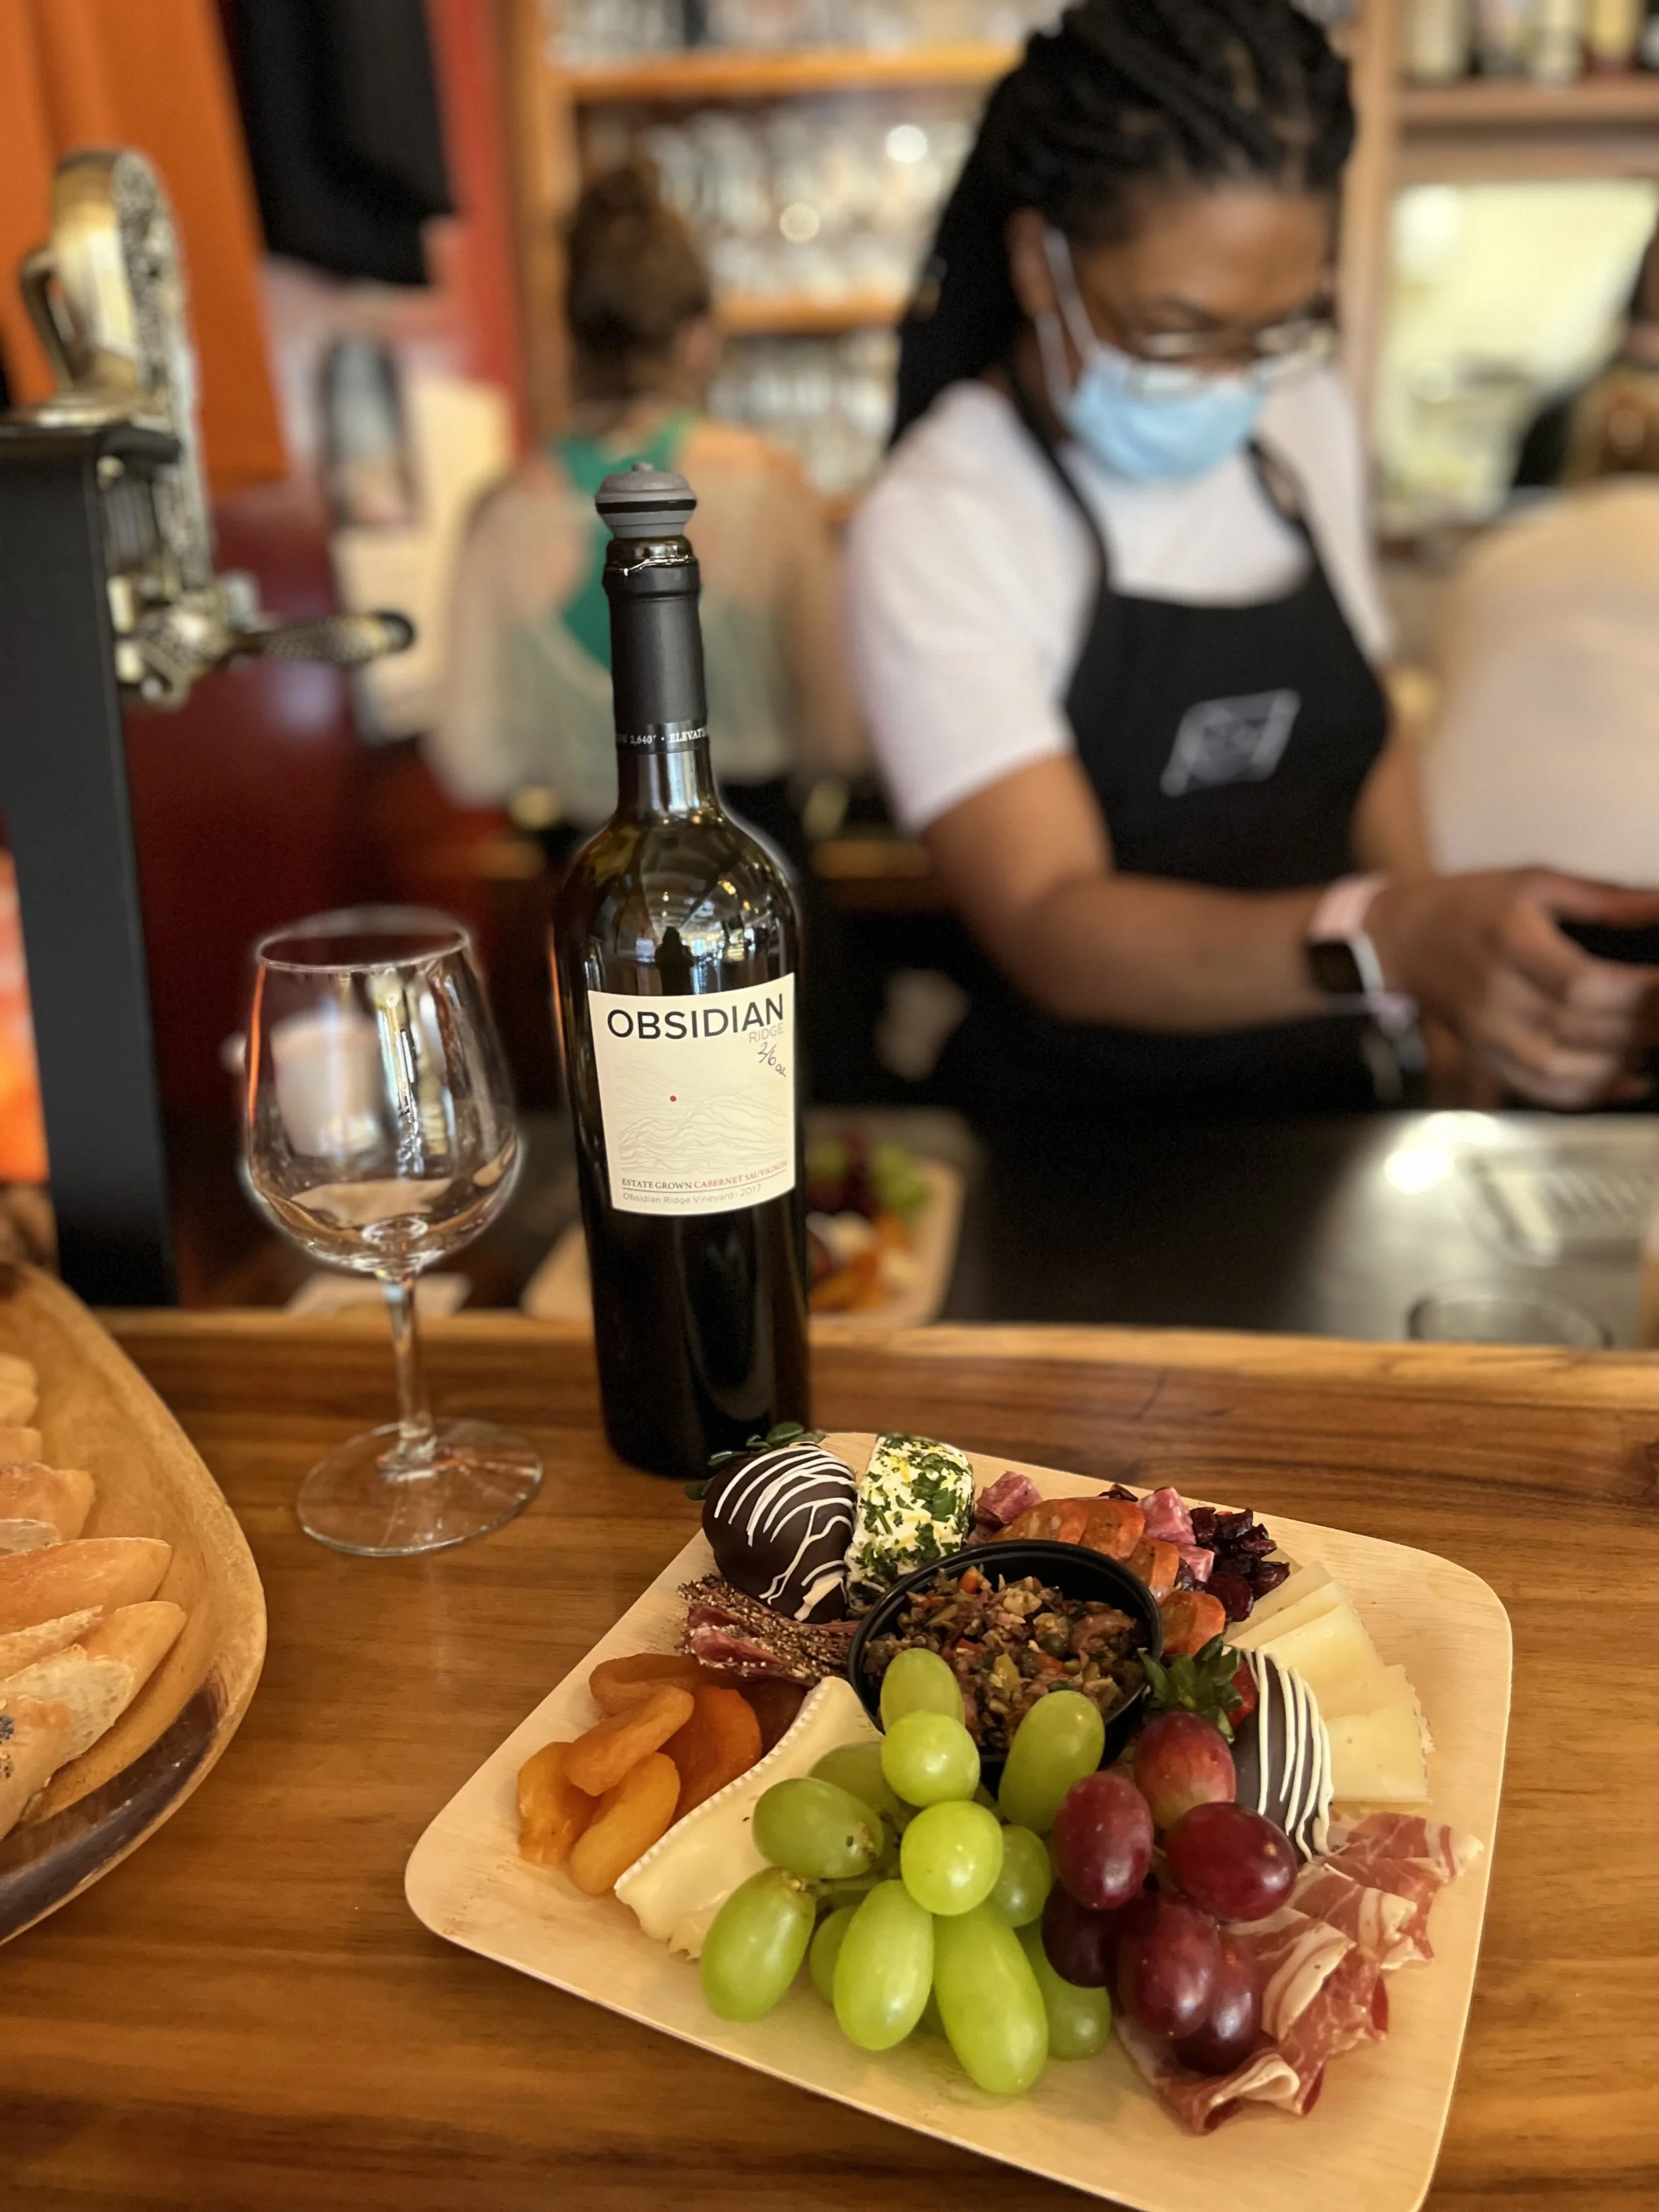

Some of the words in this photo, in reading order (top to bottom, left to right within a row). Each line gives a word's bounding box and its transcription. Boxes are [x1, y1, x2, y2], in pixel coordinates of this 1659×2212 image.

[607, 994, 784, 1039] OBSIDIAN
[749, 1022, 784, 1043] RIDGE
[622, 1179, 654, 1189] ESTATE
[694, 1175, 743, 1189] CABERNET
[745, 1161, 788, 1181] SAUVIGNON
[623, 1193, 661, 1203] Obsidian
[664, 1196, 691, 1205] Ridge
[693, 1192, 733, 1203] Vineyard
[740, 1184, 761, 1197] 2017
